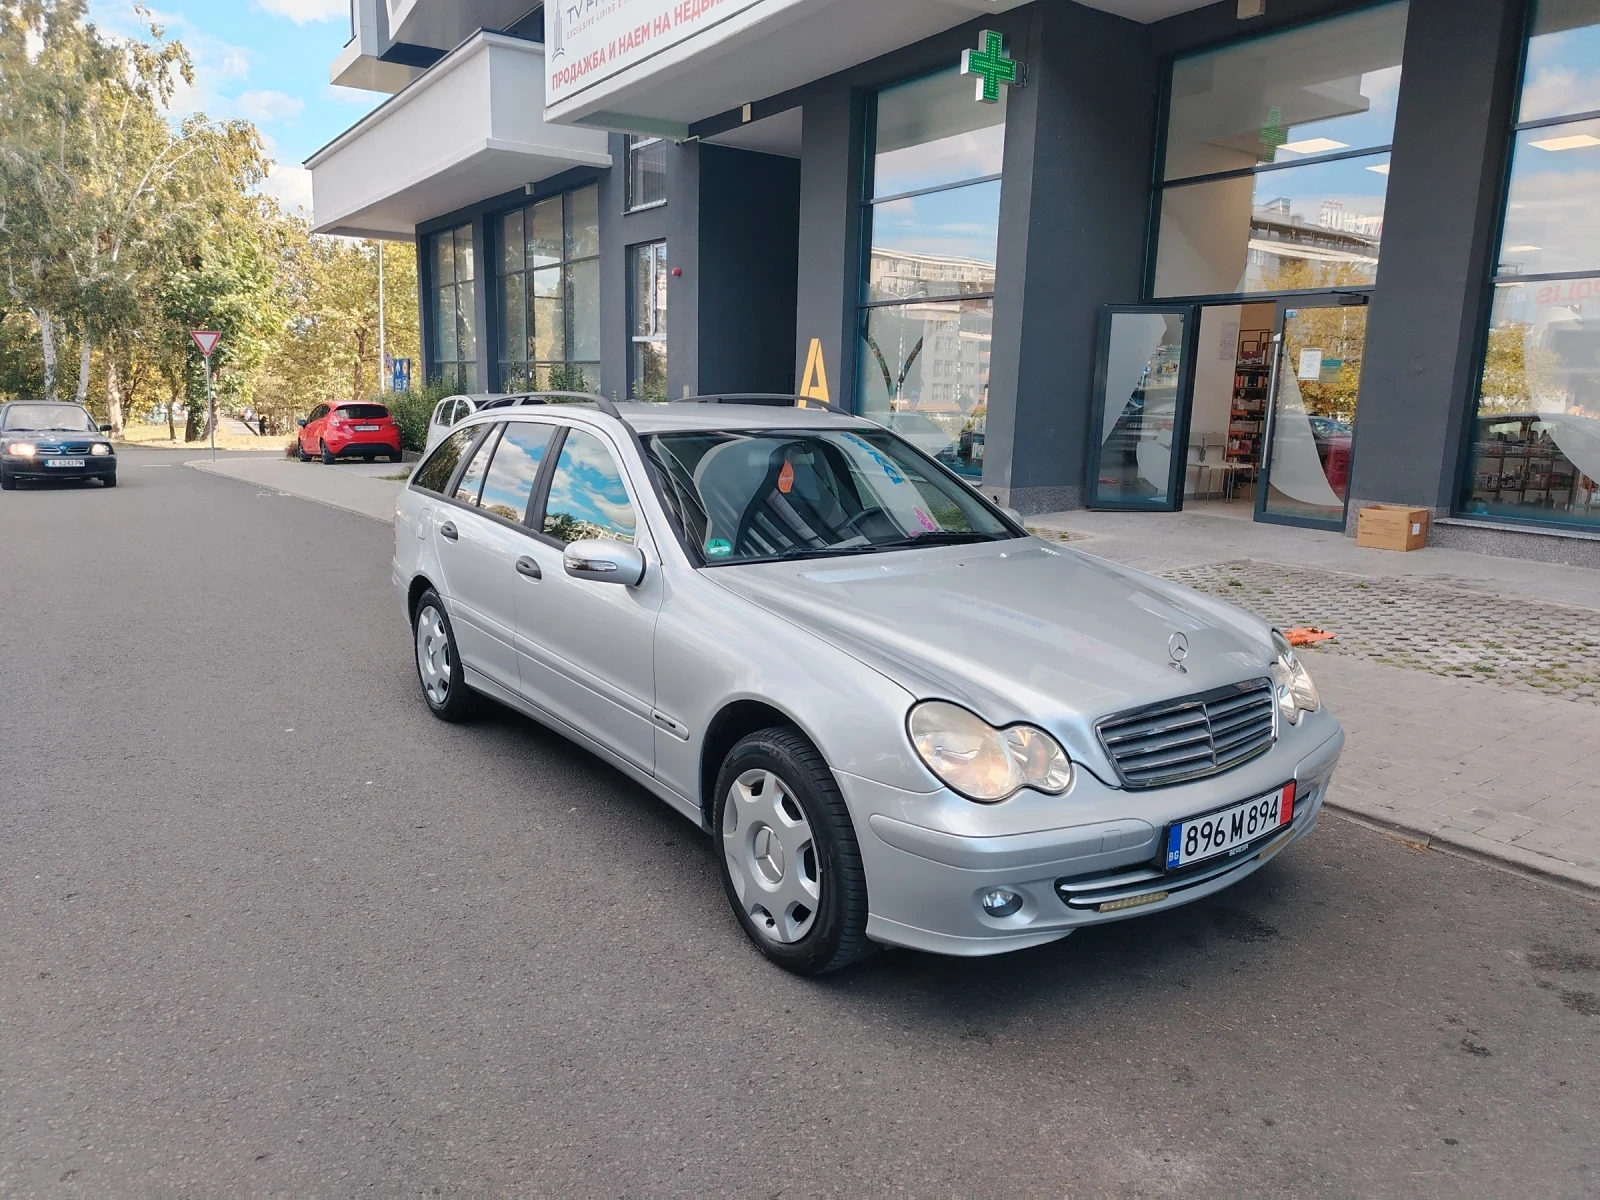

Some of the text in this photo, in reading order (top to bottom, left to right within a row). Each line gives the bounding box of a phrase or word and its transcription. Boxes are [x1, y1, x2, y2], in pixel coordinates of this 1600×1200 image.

[567, 0, 582, 24] TV
[567, 16, 594, 39] EXCLUSIVE
[597, 3, 616, 21] LIVING
[552, 47, 606, 91] ПРОДАЖБА
[609, 41, 615, 61] И
[619, 22, 650, 55] НАЕМ
[653, 12, 671, 38] НА
[1185, 817, 1226, 856] 896
[1230, 810, 1245, 842] M
[1247, 795, 1279, 834] 894
[1168, 850, 1180, 862] BG
